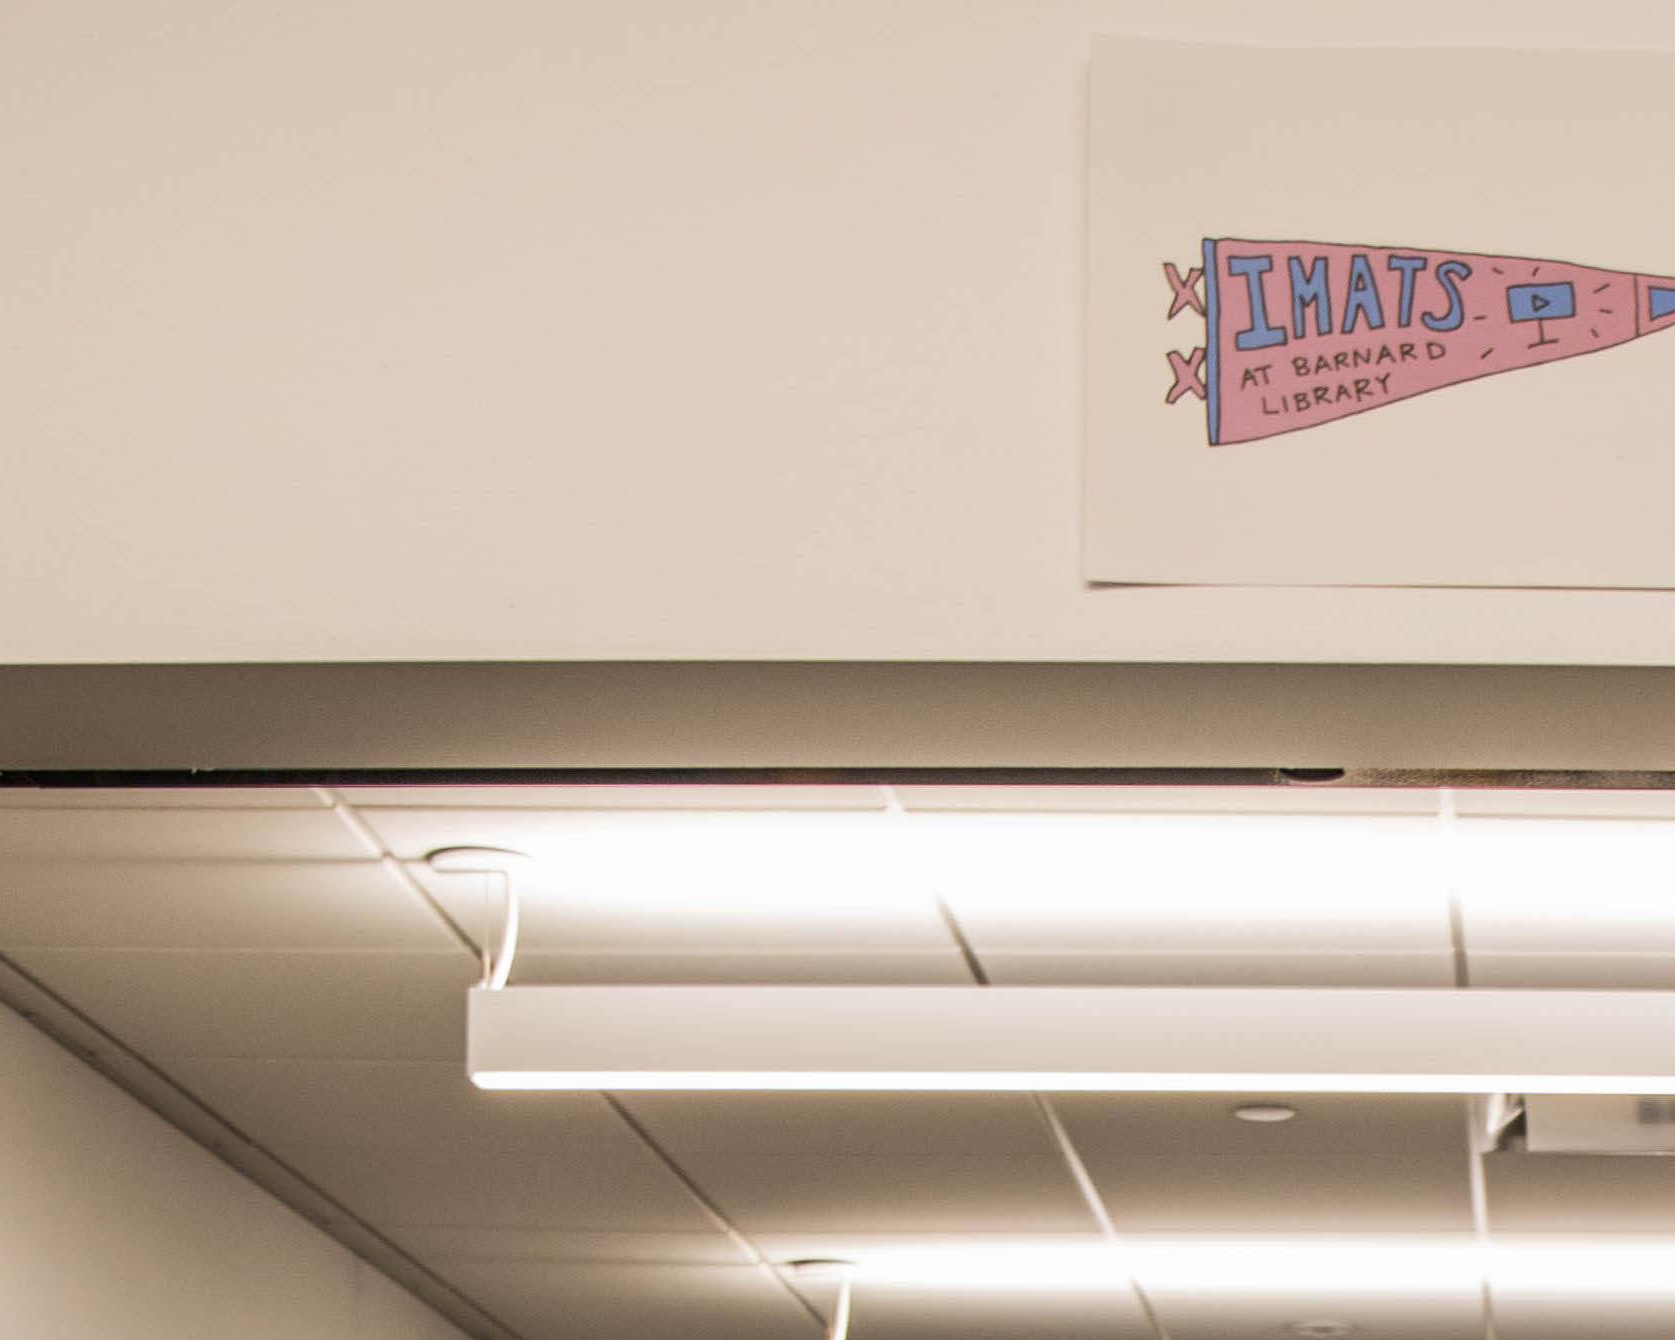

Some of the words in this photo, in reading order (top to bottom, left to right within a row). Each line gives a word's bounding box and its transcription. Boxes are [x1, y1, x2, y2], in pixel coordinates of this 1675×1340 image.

[1227, 255, 1472, 351] IMATS
[1240, 364, 1273, 391] AT
[1293, 340, 1447, 380] BARNARD
[1262, 375, 1394, 416] LIBRARY
